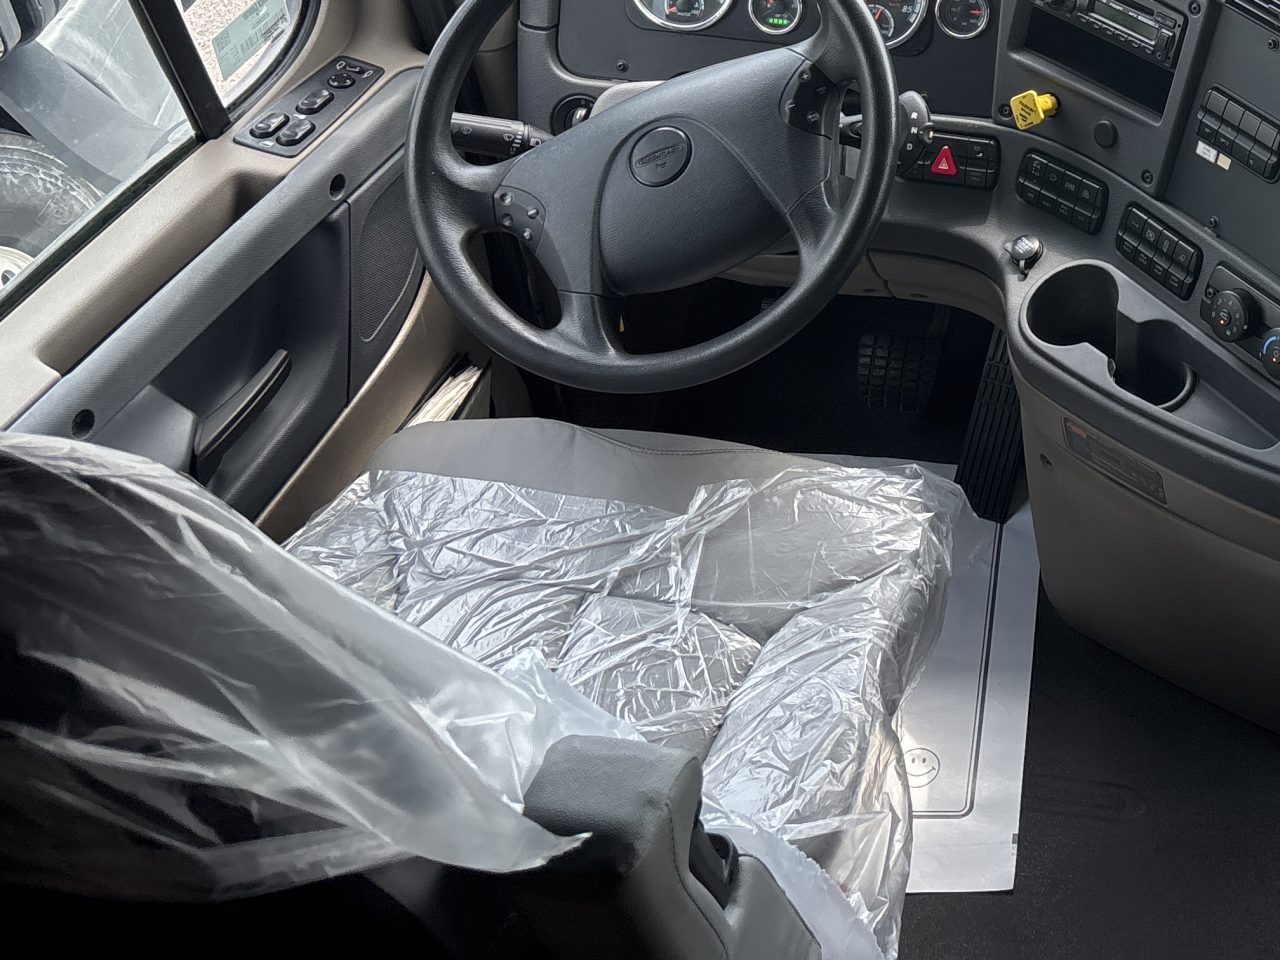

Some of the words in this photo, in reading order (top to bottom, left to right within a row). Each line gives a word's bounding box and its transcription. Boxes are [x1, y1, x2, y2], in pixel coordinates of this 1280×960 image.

[901, 5, 913, 14] 85
[910, 111, 918, 120] R
[910, 126, 918, 134] N
[906, 142, 913, 151] D
